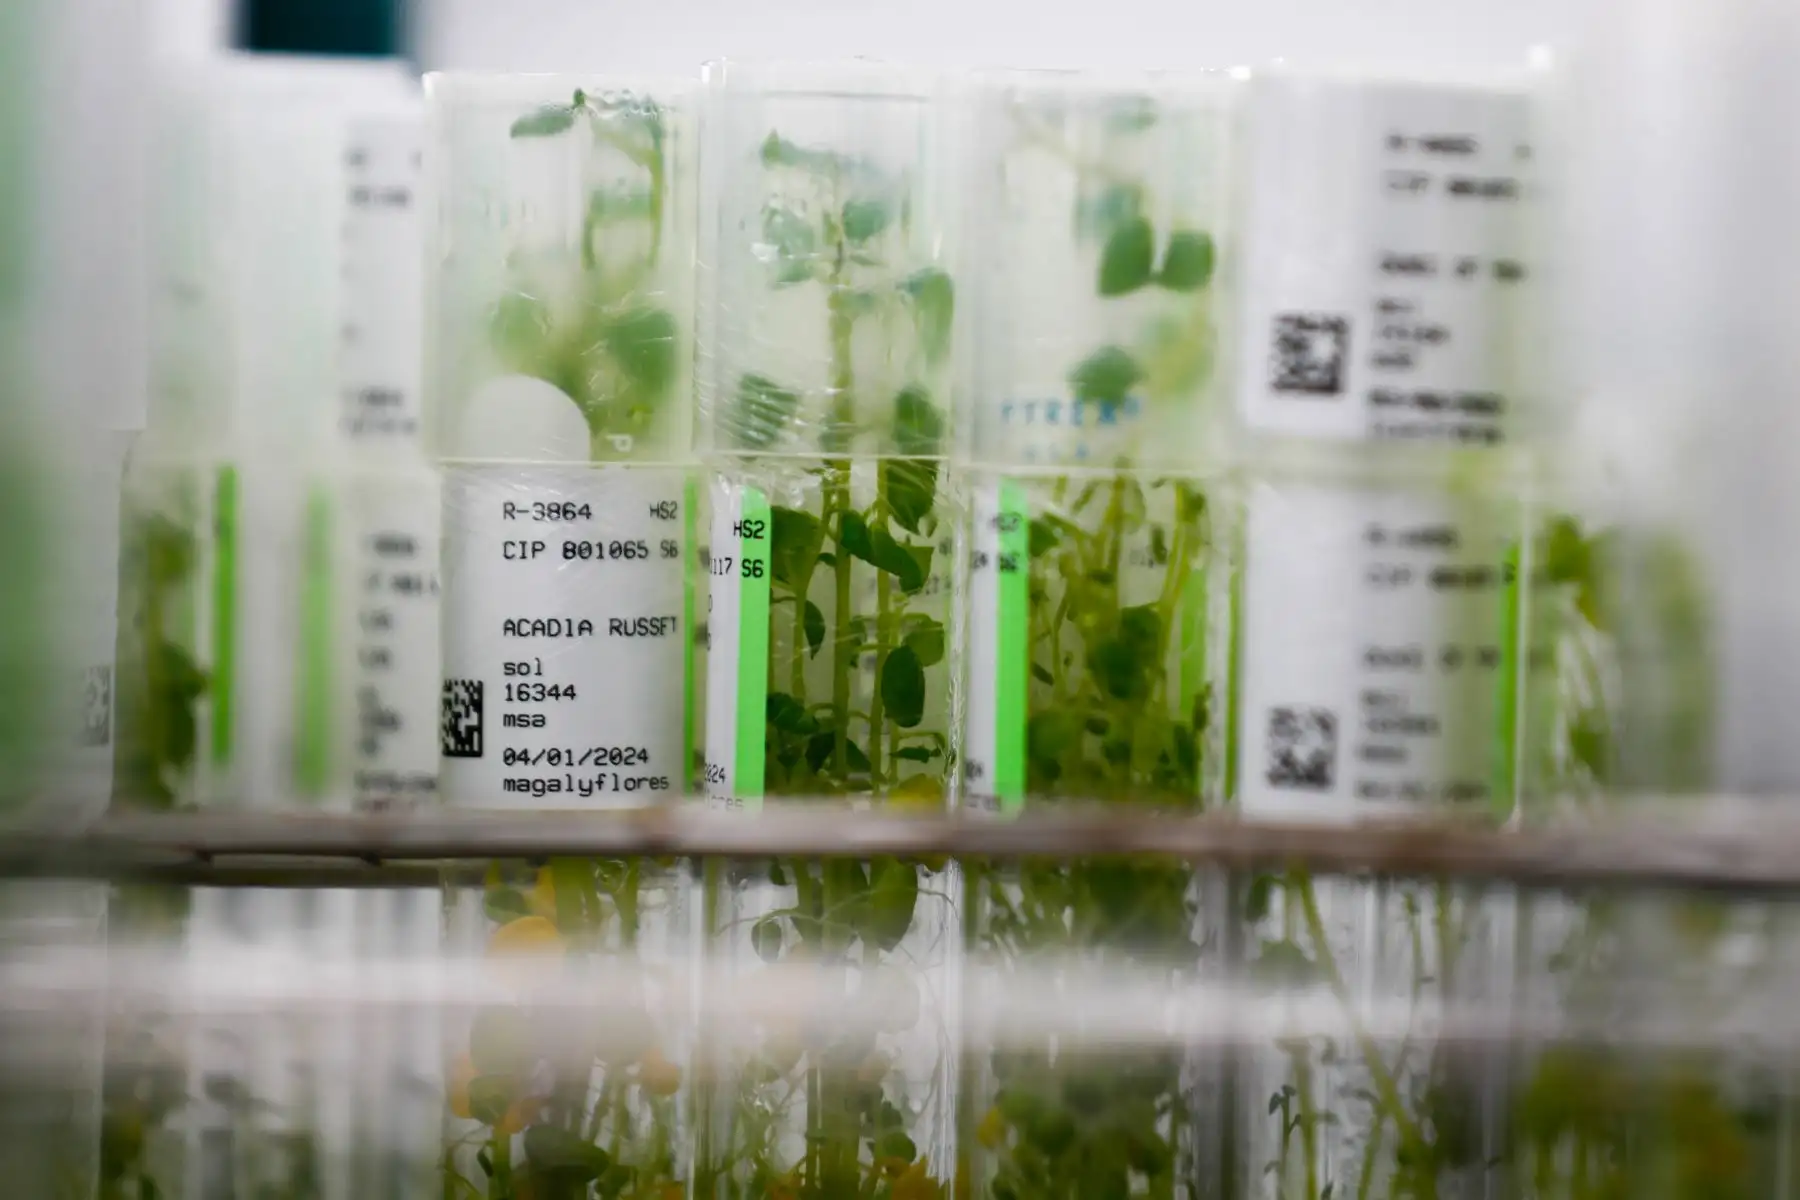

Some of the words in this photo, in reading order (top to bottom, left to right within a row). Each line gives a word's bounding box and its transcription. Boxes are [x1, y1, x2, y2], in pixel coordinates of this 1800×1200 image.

[502, 501, 593, 522] R-3864
[649, 500, 678, 521] HS2
[733, 519, 765, 540] HS2
[502, 540, 546, 560] CIP
[562, 540, 650, 560] 801065
[741, 557, 765, 579] S6
[502, 656, 543, 677] sol
[504, 682, 577, 703] 16344
[502, 713, 546, 729] msa
[502, 746, 650, 767] 04/01/2024
[502, 772, 670, 798] magalyflores
